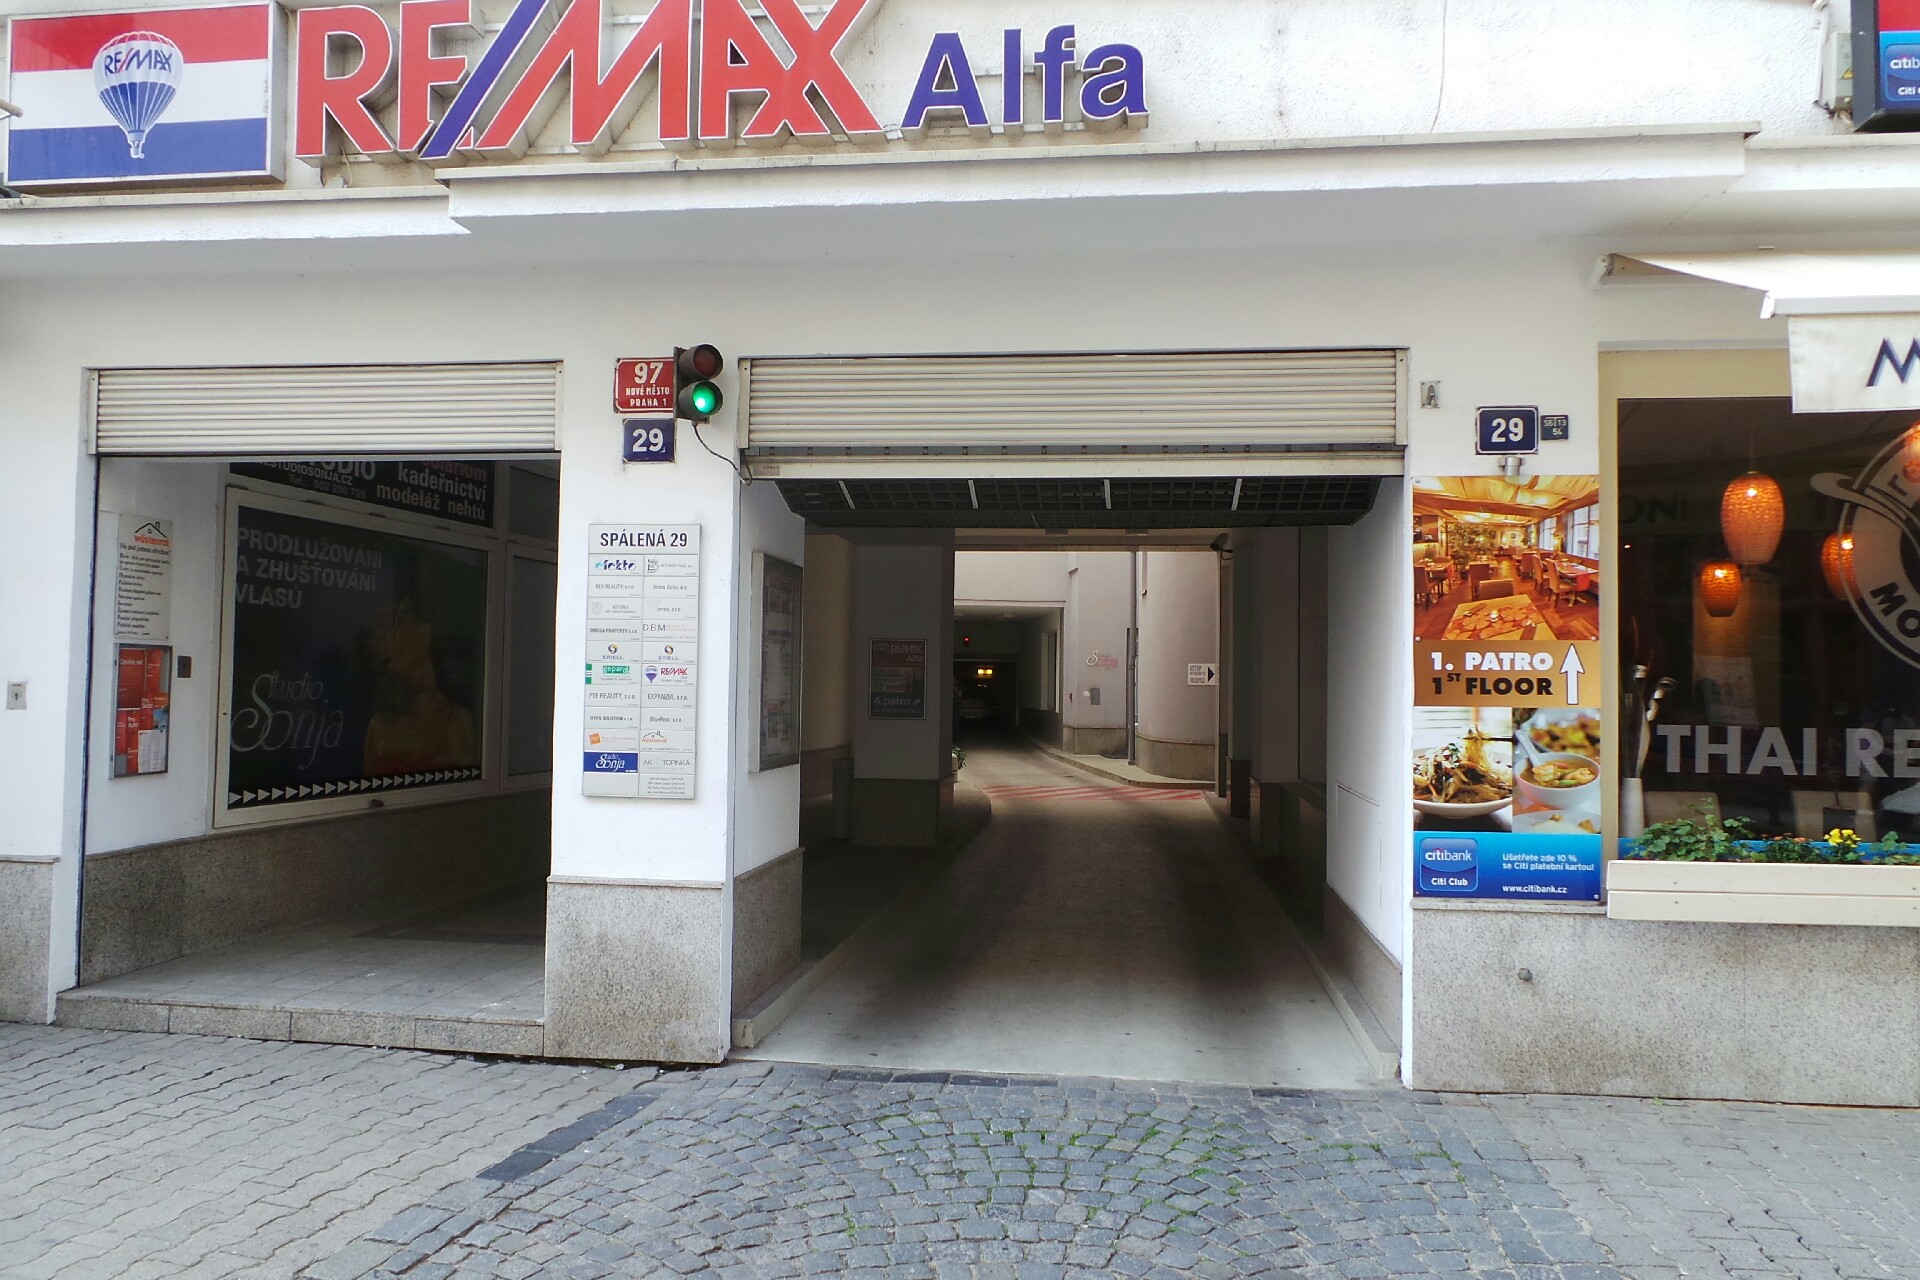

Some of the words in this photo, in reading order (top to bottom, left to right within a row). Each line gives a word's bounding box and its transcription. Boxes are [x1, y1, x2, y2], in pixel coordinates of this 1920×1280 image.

[102, 40, 173, 76] RE/MAX
[295, 0, 885, 159] RE/MAX
[900, 24, 1150, 128] Alfa
[634, 362, 664, 384] 97
[626, 384, 644, 396] NOVÉ
[646, 384, 670, 396] MĚSTO
[630, 398, 658, 406] PRAHA
[662, 398, 666, 406] 1
[1490, 417, 1524, 442] 29
[632, 428, 664, 452] 29
[398, 462, 488, 502] kadeřnictví
[376, 482, 440, 512] modeláž
[448, 500, 485, 520] nehtů
[134, 534, 170, 547] wüstenrot
[600, 528, 666, 547] SPÁLENÁ
[670, 532, 688, 547] 29
[238, 528, 383, 568] PRODLUŽOVÁNÍ
[238, 557, 248, 575] A
[256, 558, 377, 592] ZHUŠŤOVÁNÍ
[1431, 652, 1454, 671] 1.
[1465, 652, 1554, 671] PATRO
[660, 667, 688, 676] RE/MAX
[251, 670, 324, 700] Studio
[1465, 677, 1553, 695] FLOOR
[884, 698, 910, 707] patro
[231, 673, 344, 770] Sonja
[1656, 724, 1817, 776] THAI
[595, 754, 625, 772] Sonja
[1425, 847, 1472, 862] citibank
[1502, 853, 1539, 862] Ušetřete
[1540, 854, 1555, 862] zde
[1557, 854, 1566, 862] 10
[1568, 854, 1577, 862] %
[1530, 862, 1564, 872] platební
[1565, 862, 1594, 871] kartou!
[1431, 878, 1446, 886] Citi
[1448, 878, 1468, 886] Club
[1502, 885, 1567, 893] www.citibank.cz
